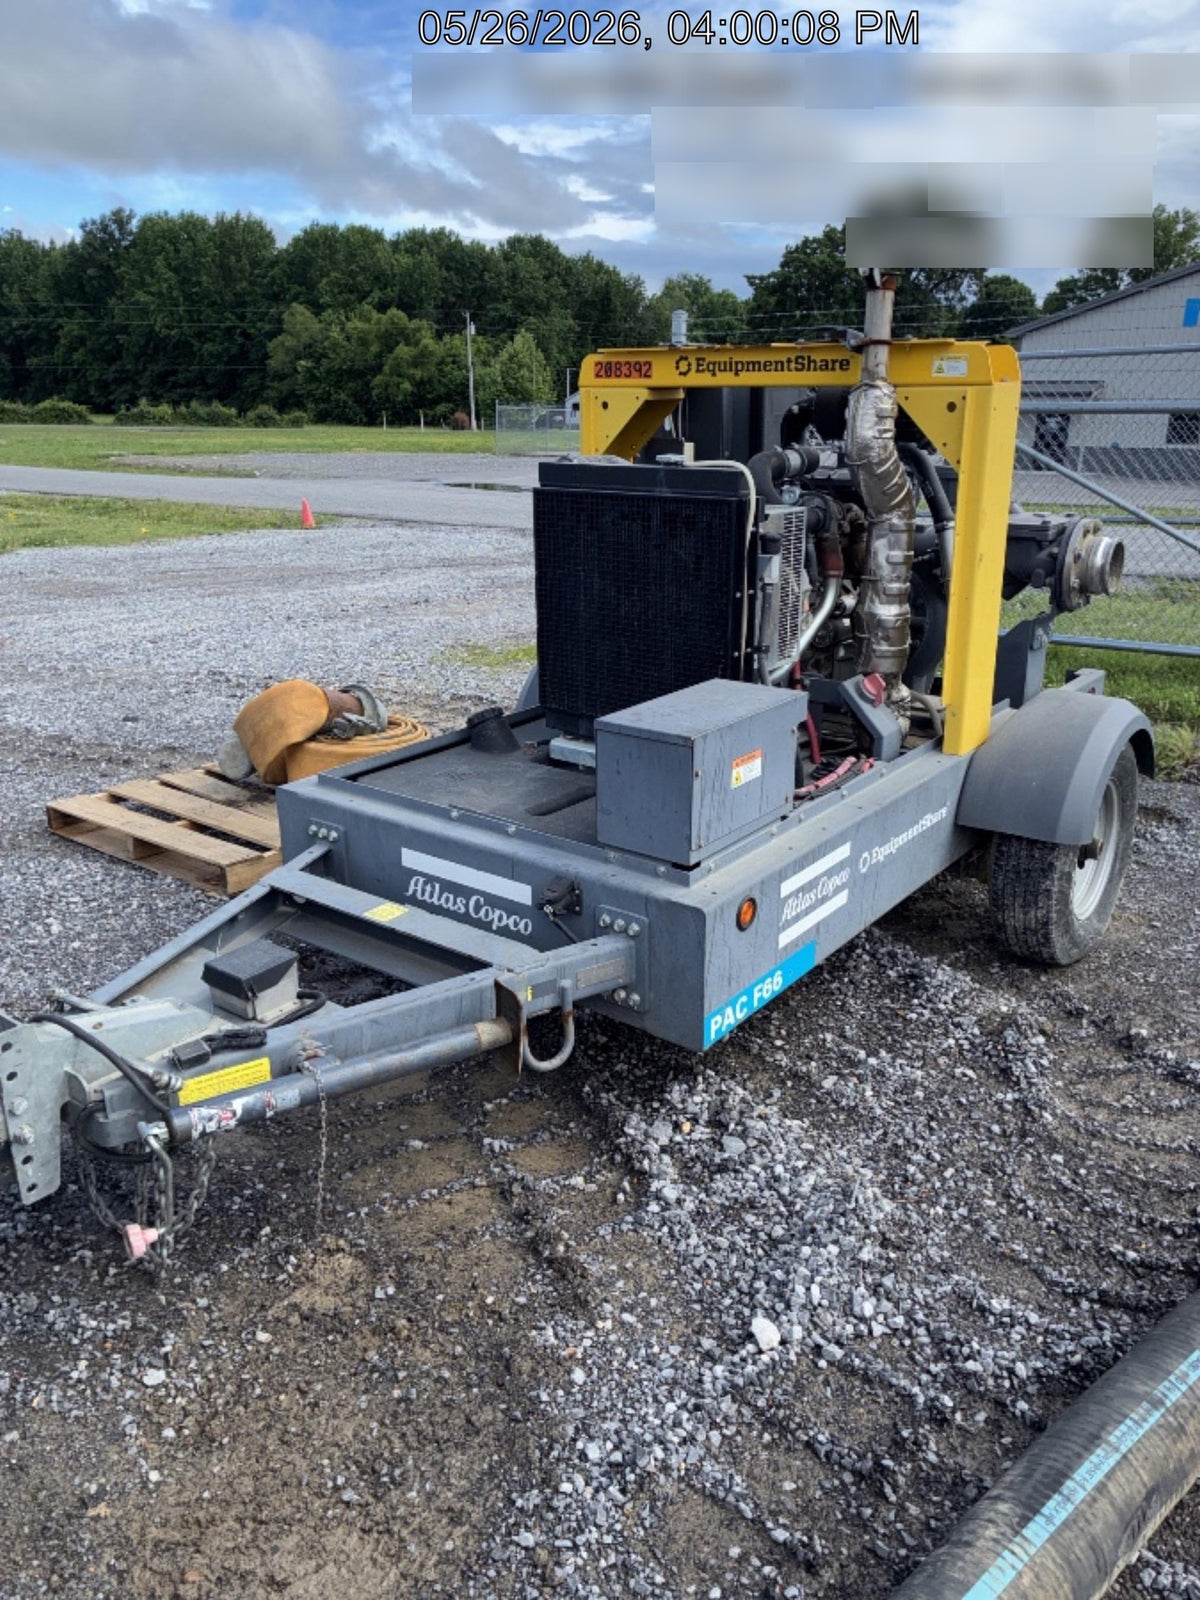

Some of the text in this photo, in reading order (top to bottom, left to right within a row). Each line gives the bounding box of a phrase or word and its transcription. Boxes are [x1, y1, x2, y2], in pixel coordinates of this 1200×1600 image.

[594, 360, 652, 379] 208392
[694, 354, 850, 377] EquipmentShare
[871, 806, 948, 865] EquipmentShare
[710, 971, 783, 1040] PAC F66
